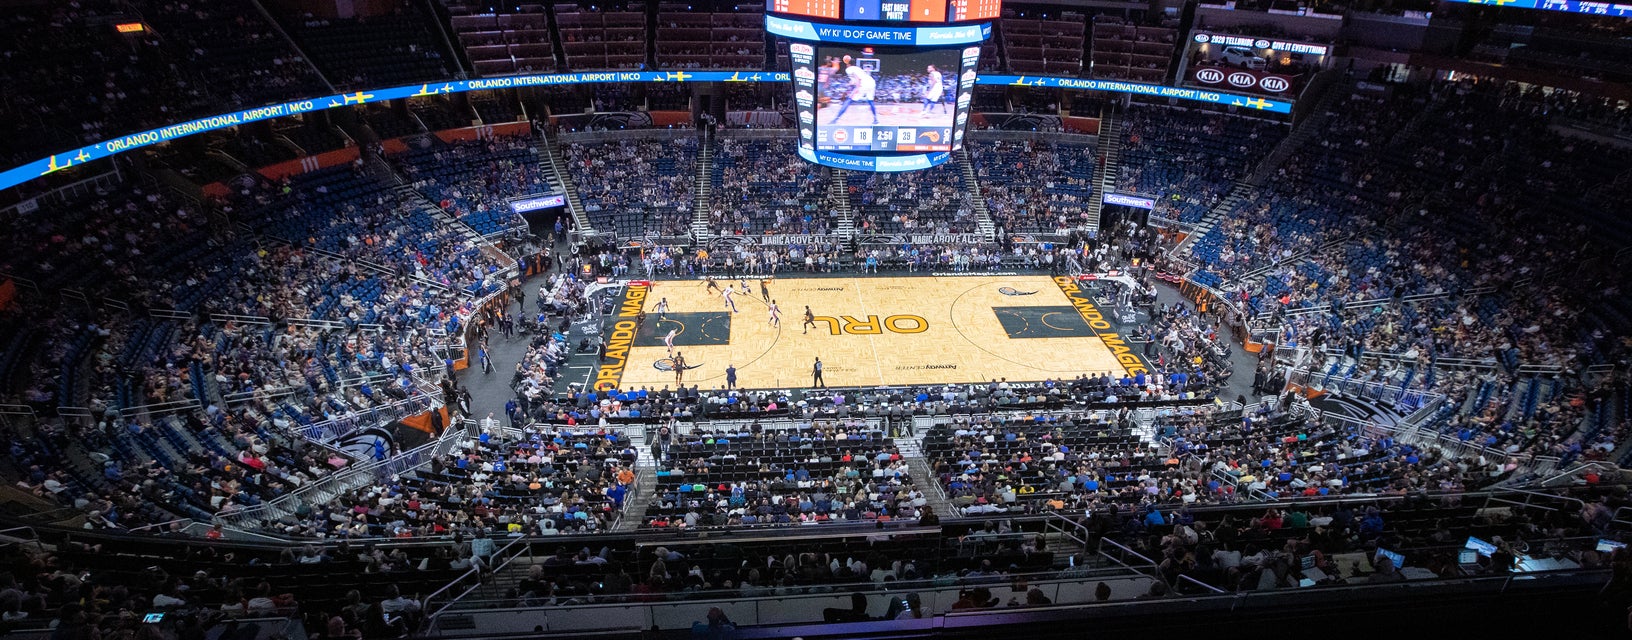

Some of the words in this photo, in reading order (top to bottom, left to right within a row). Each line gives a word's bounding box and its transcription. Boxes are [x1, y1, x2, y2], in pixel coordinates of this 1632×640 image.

[881, 3, 893, 12] FAST
[893, 4, 909, 12] BREAK
[820, 28, 832, 37] MY
[852, 30, 865, 39] OF
[866, 31, 891, 40] GAME
[893, 32, 912, 40] TIME
[468, 78, 512, 89] ORLANDO
[513, 74, 580, 86] INTERNATIONAL
[581, 73, 616, 81] AIRPORT
[620, 72, 641, 81] MCO
[1058, 78, 1097, 89] ORLANDO
[1097, 81, 1159, 95] INTERNATIONAL
[1160, 87, 1196, 99] AIRPORT
[1199, 91, 1220, 102] MCO
[106, 131, 159, 152] ORLANDO
[160, 114, 240, 139] INTERNATIONAL
[243, 105, 283, 122] AIRPORT
[289, 101, 313, 113] MCO
[859, 131, 867, 141] 18
[515, 199, 557, 211] Southwest
[1107, 194, 1146, 207] Southwest
[762, 236, 784, 245] MAGIC
[784, 235, 814, 244] ABOVE
[911, 235, 933, 244] MAGIC
[933, 234, 960, 243] ABOVE
[808, 314, 930, 336] ORL
[1053, 276, 1111, 330] ORLANDO
[1098, 332, 1149, 378] MAGIC
[593, 320, 637, 392] ORLANDO
